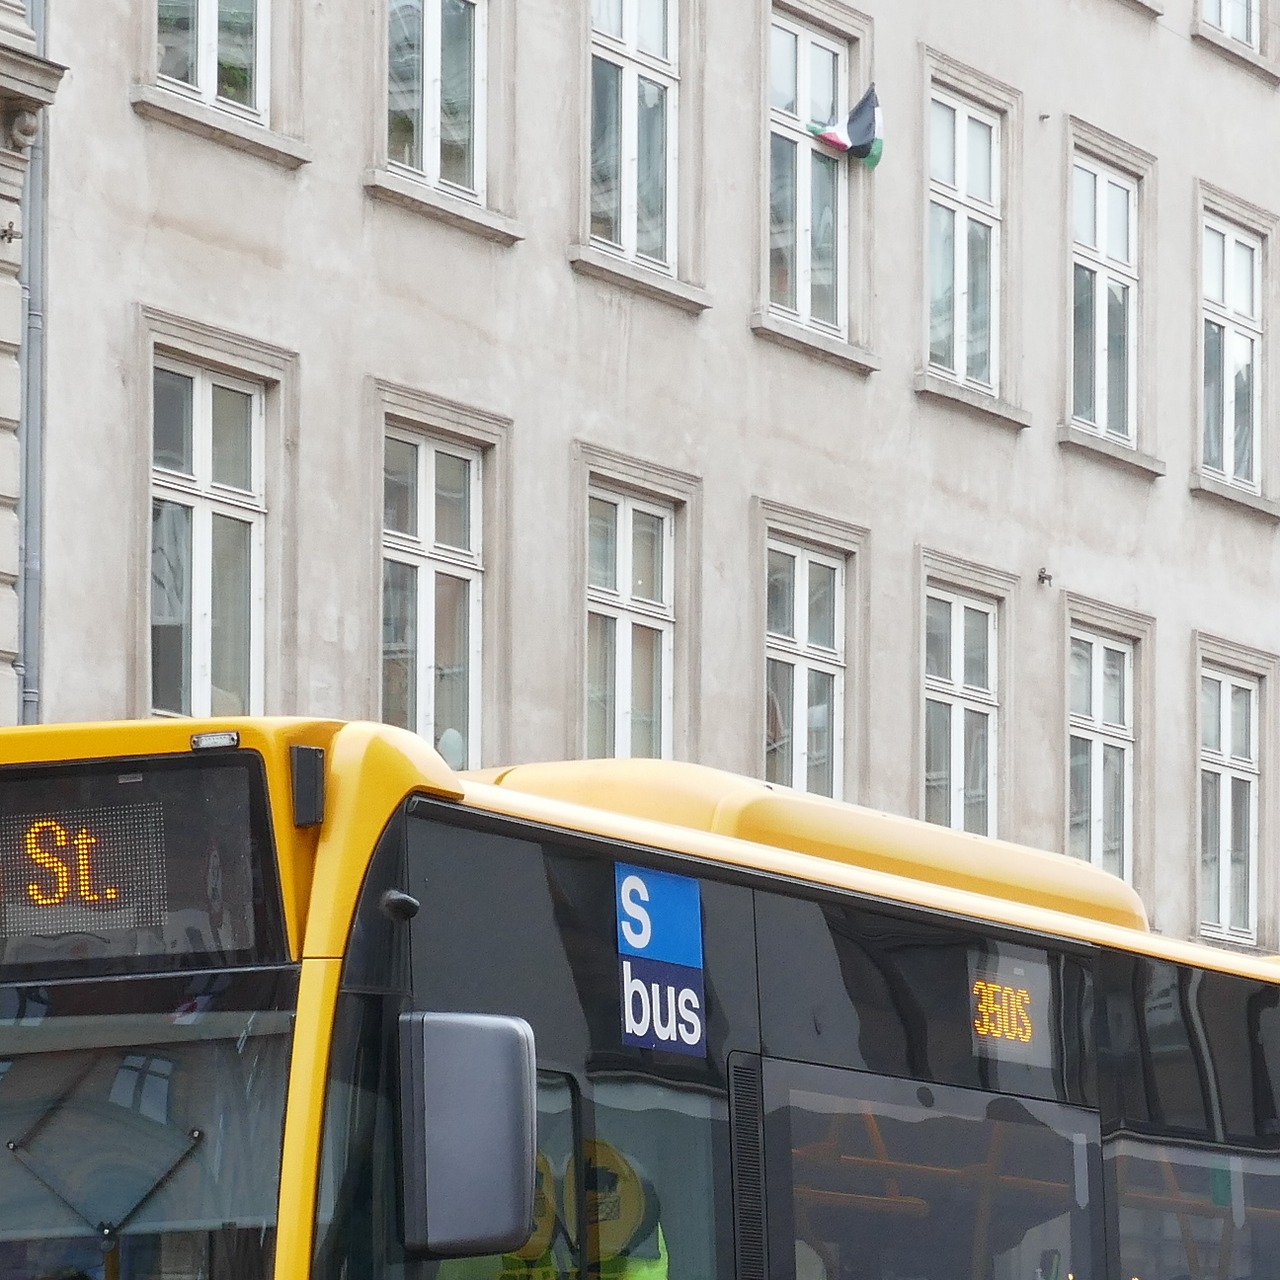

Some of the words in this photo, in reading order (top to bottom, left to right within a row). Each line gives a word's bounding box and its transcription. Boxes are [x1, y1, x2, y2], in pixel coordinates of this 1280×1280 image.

[25, 820, 119, 907] St.
[620, 875, 652, 949] S
[622, 961, 703, 1046] bus
[972, 980, 1033, 1043] 350S
